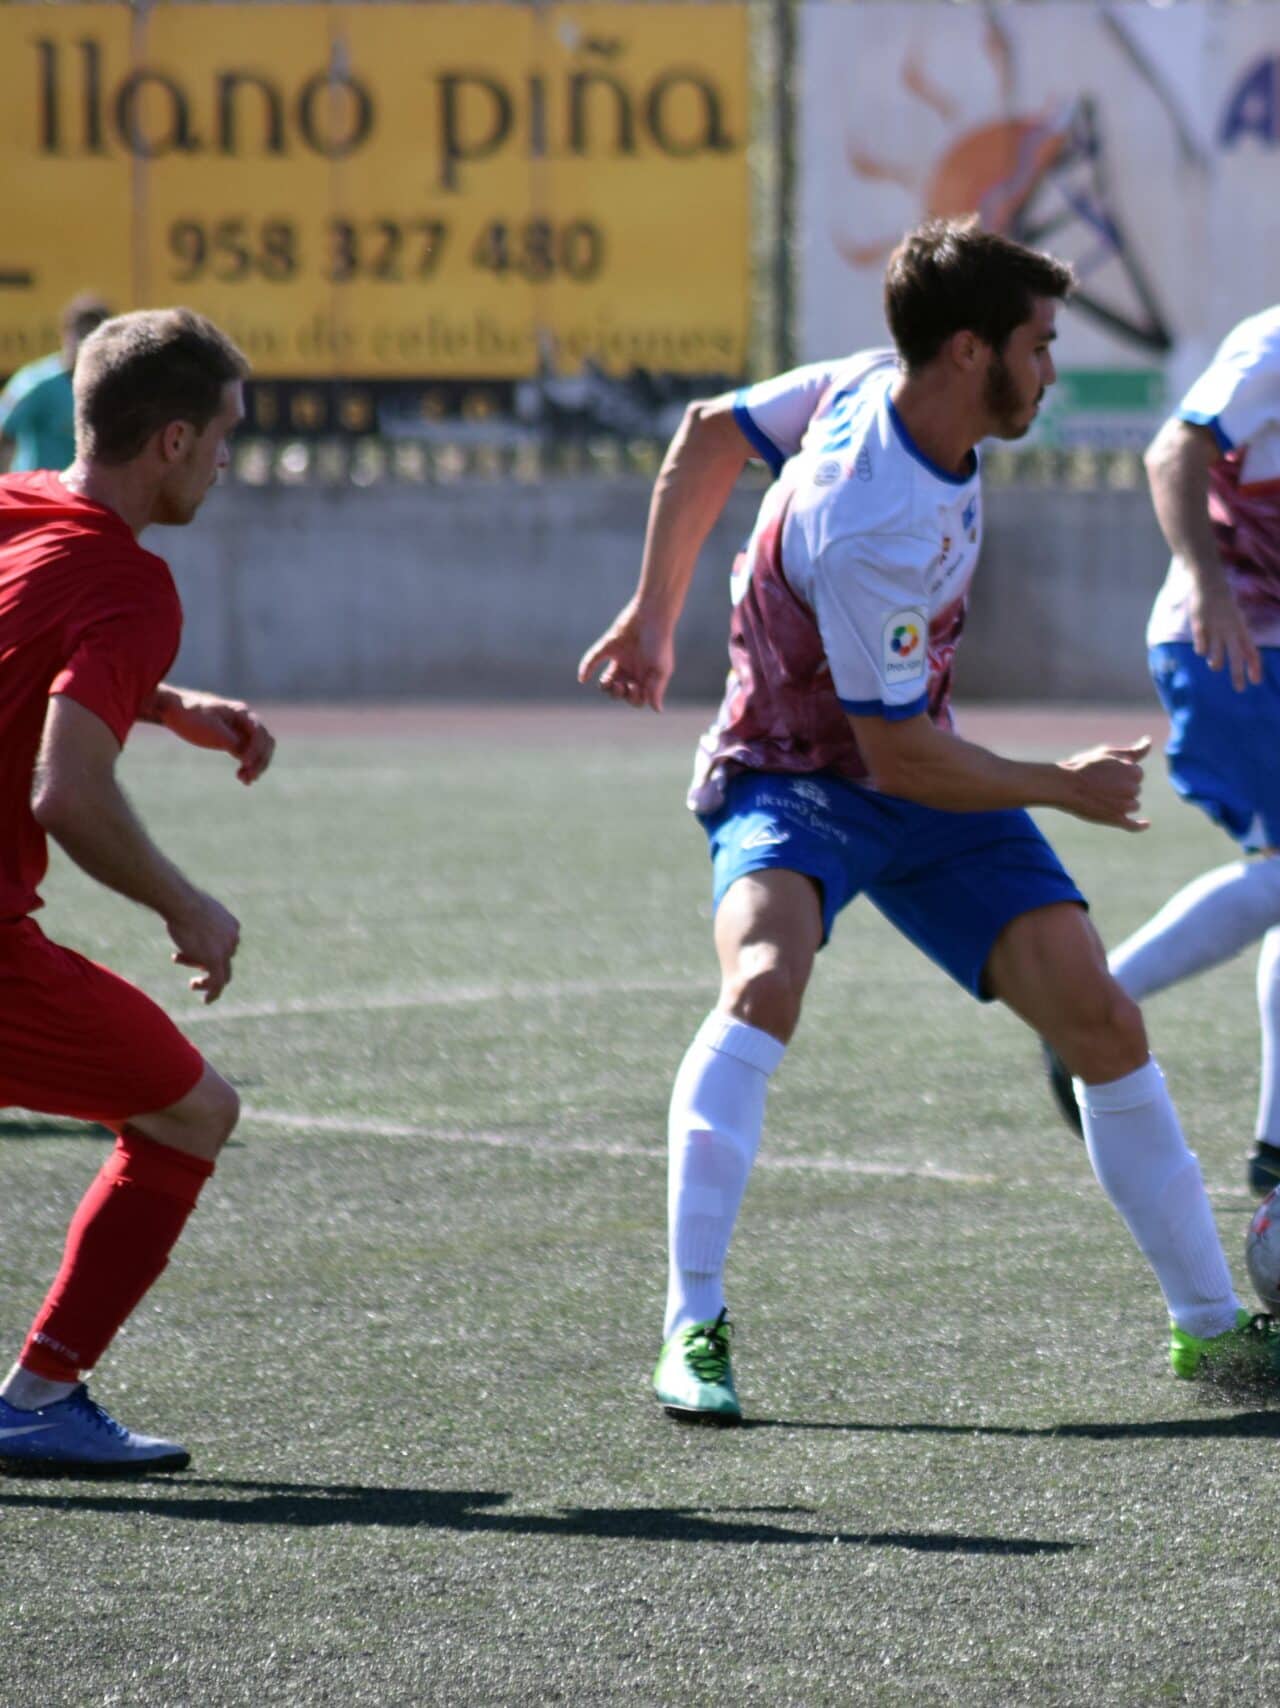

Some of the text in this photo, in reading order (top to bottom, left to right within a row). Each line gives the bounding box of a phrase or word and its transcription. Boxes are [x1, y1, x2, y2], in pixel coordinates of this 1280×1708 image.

[37, 36, 744, 192] llano piña
[168, 218, 607, 284] 958 327 480
